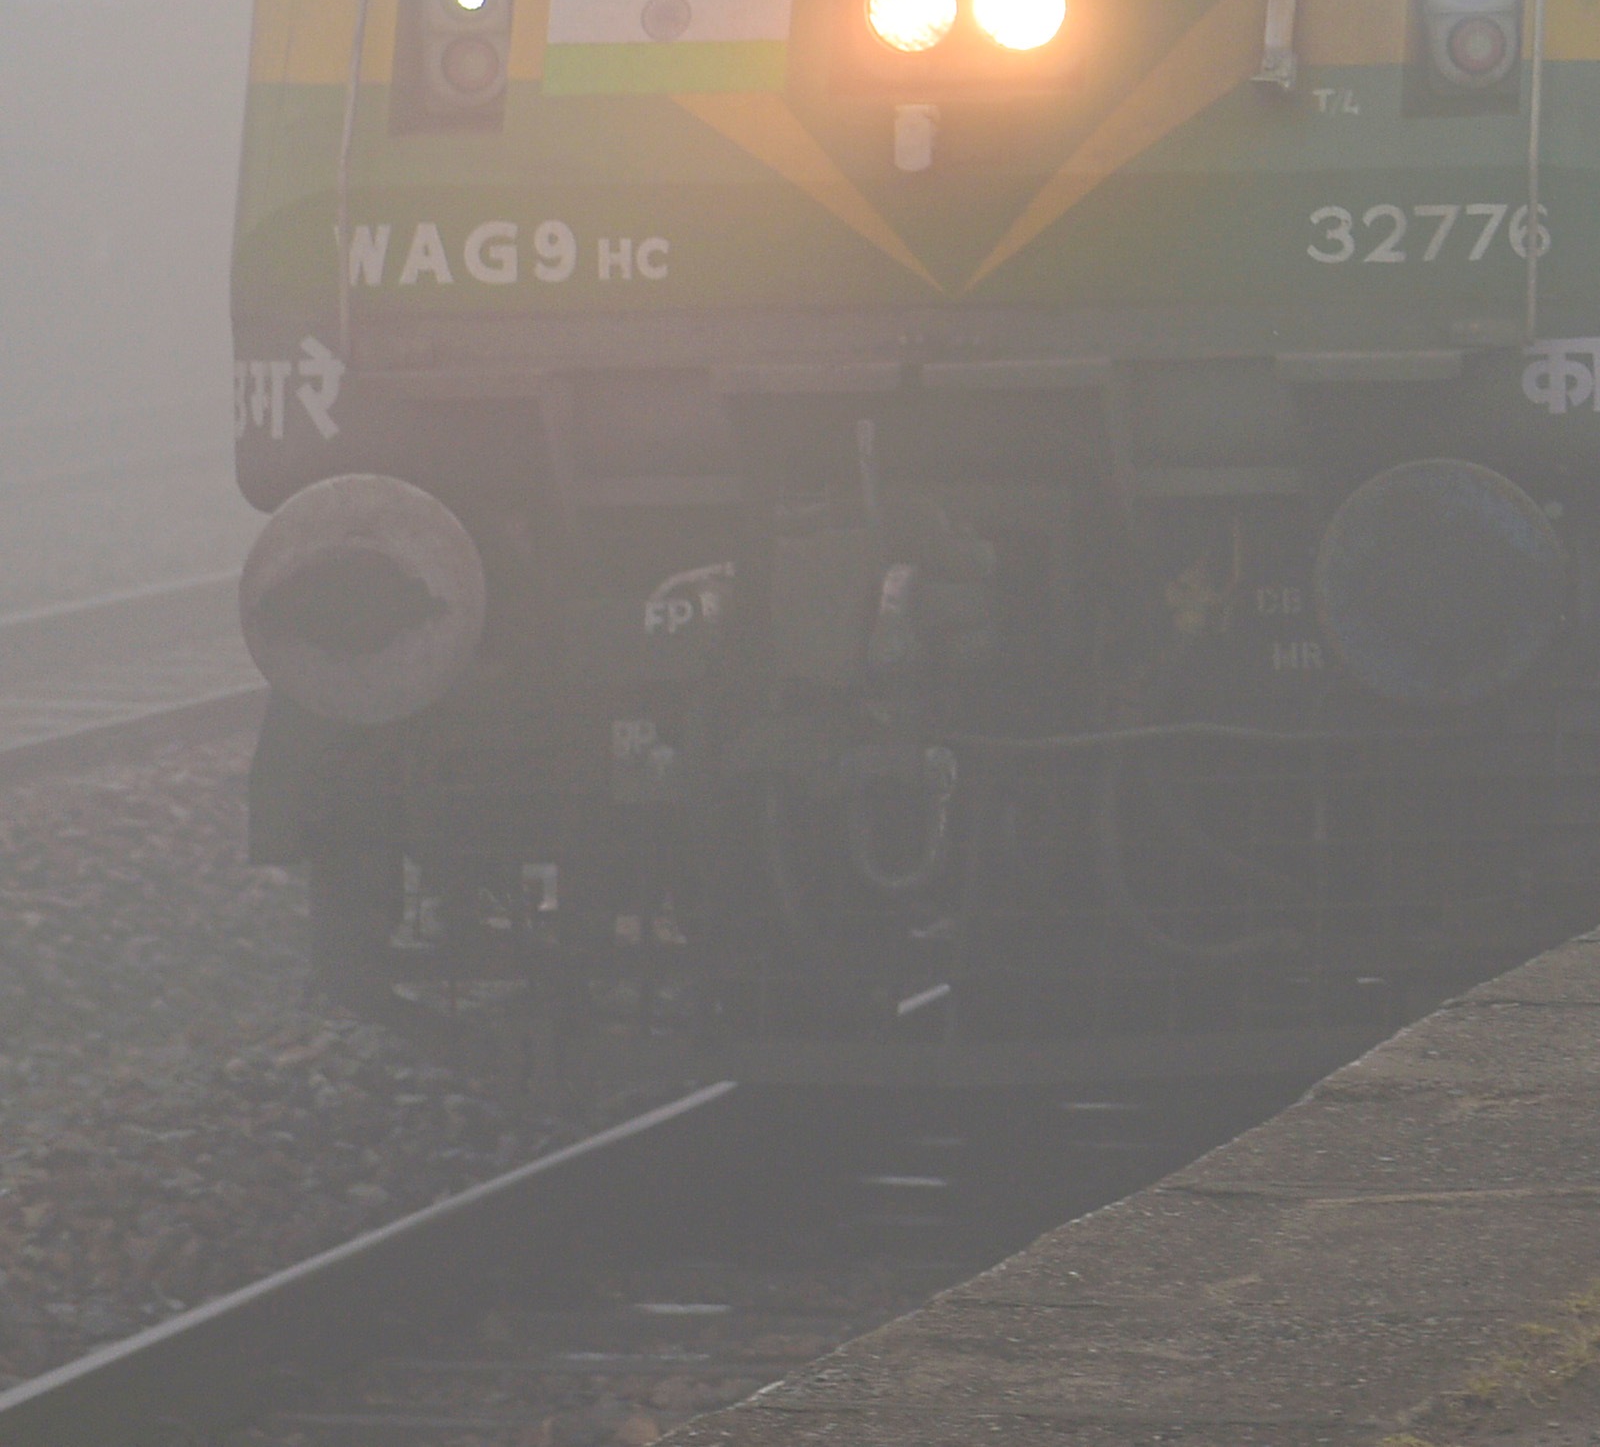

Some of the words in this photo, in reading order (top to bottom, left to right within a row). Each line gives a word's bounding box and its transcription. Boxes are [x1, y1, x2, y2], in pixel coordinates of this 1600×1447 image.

[333, 219, 579, 287] WAG9
[598, 236, 670, 282] HC
[1306, 202, 1553, 265] 32776
[1272, 641, 1325, 671] HR
